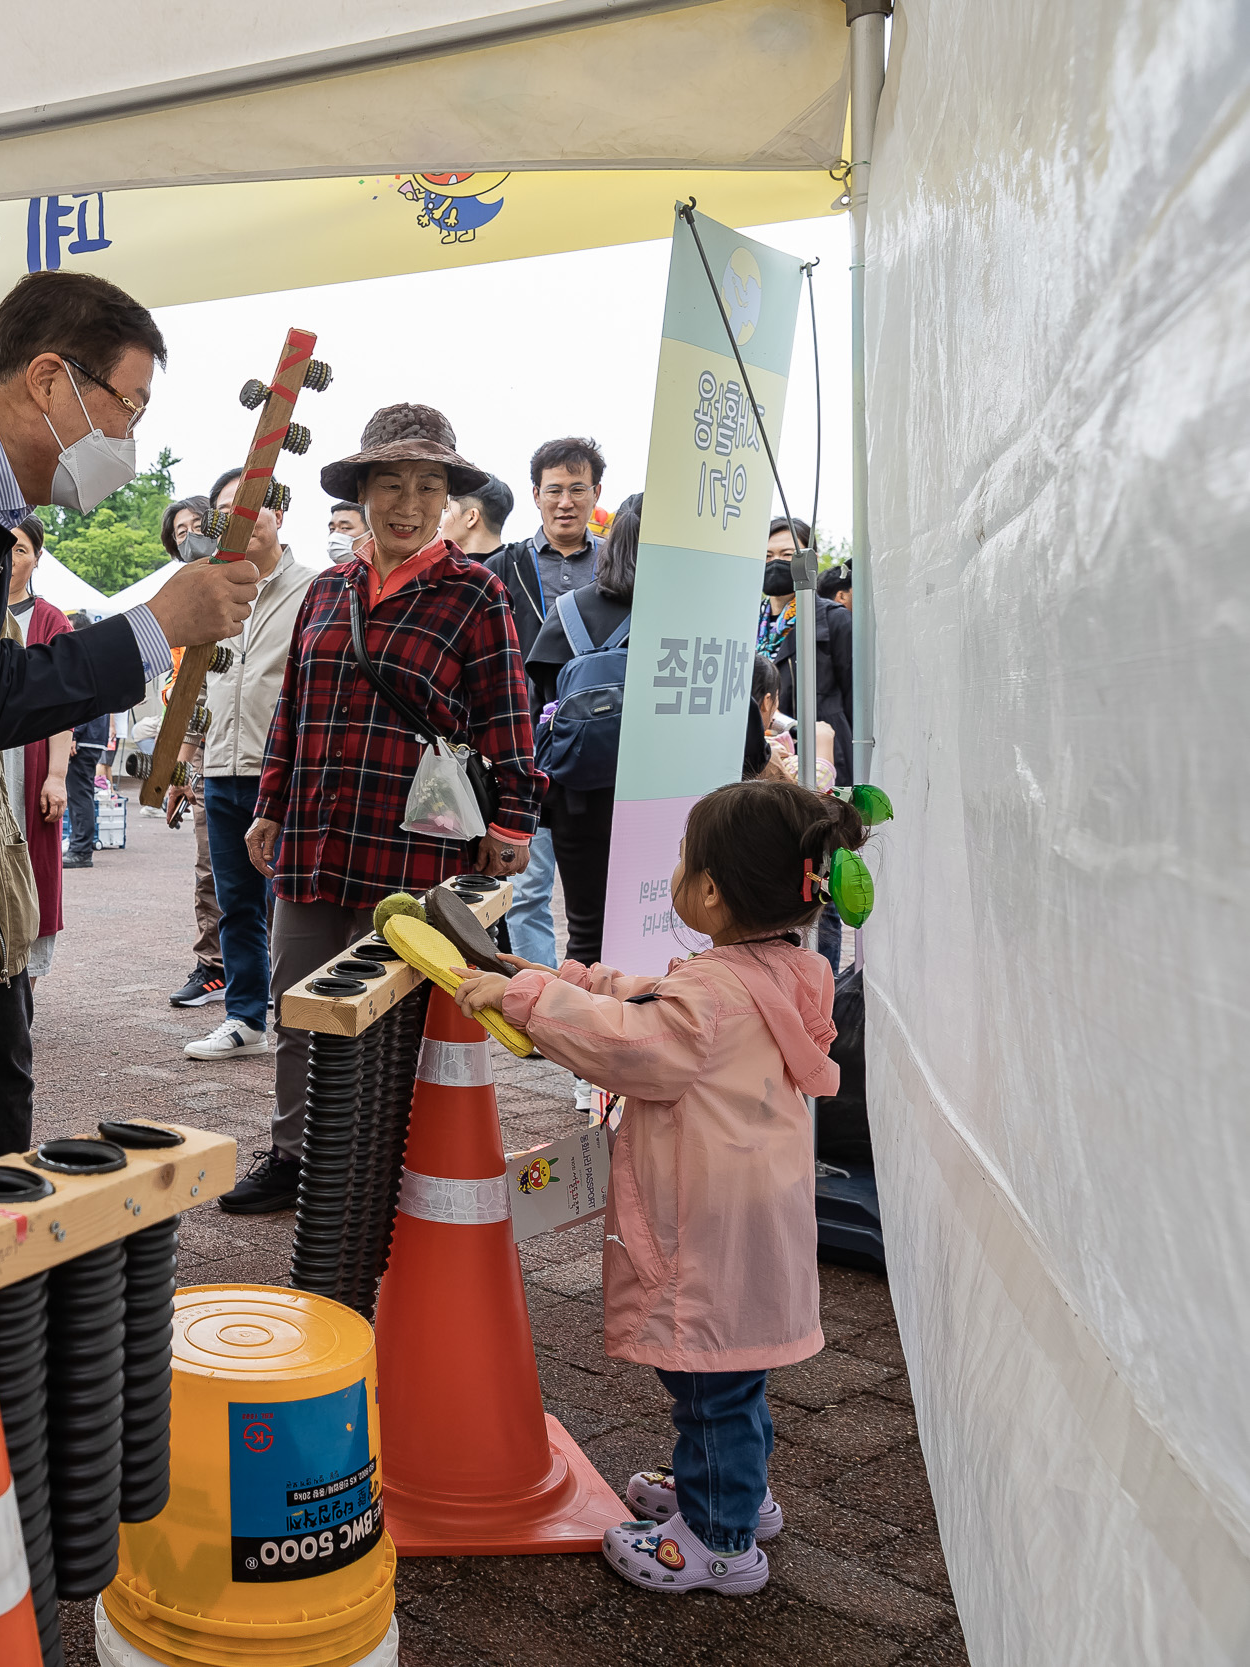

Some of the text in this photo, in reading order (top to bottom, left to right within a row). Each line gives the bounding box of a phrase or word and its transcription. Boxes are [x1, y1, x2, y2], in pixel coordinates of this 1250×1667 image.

[585, 1167, 596, 1208] PASSPORT
[293, 1491, 311, 1501] 20kg
[286, 1500, 354, 1531] 타일접착제
[338, 1508, 373, 1549] BWC
[260, 1531, 334, 1566] 5000
